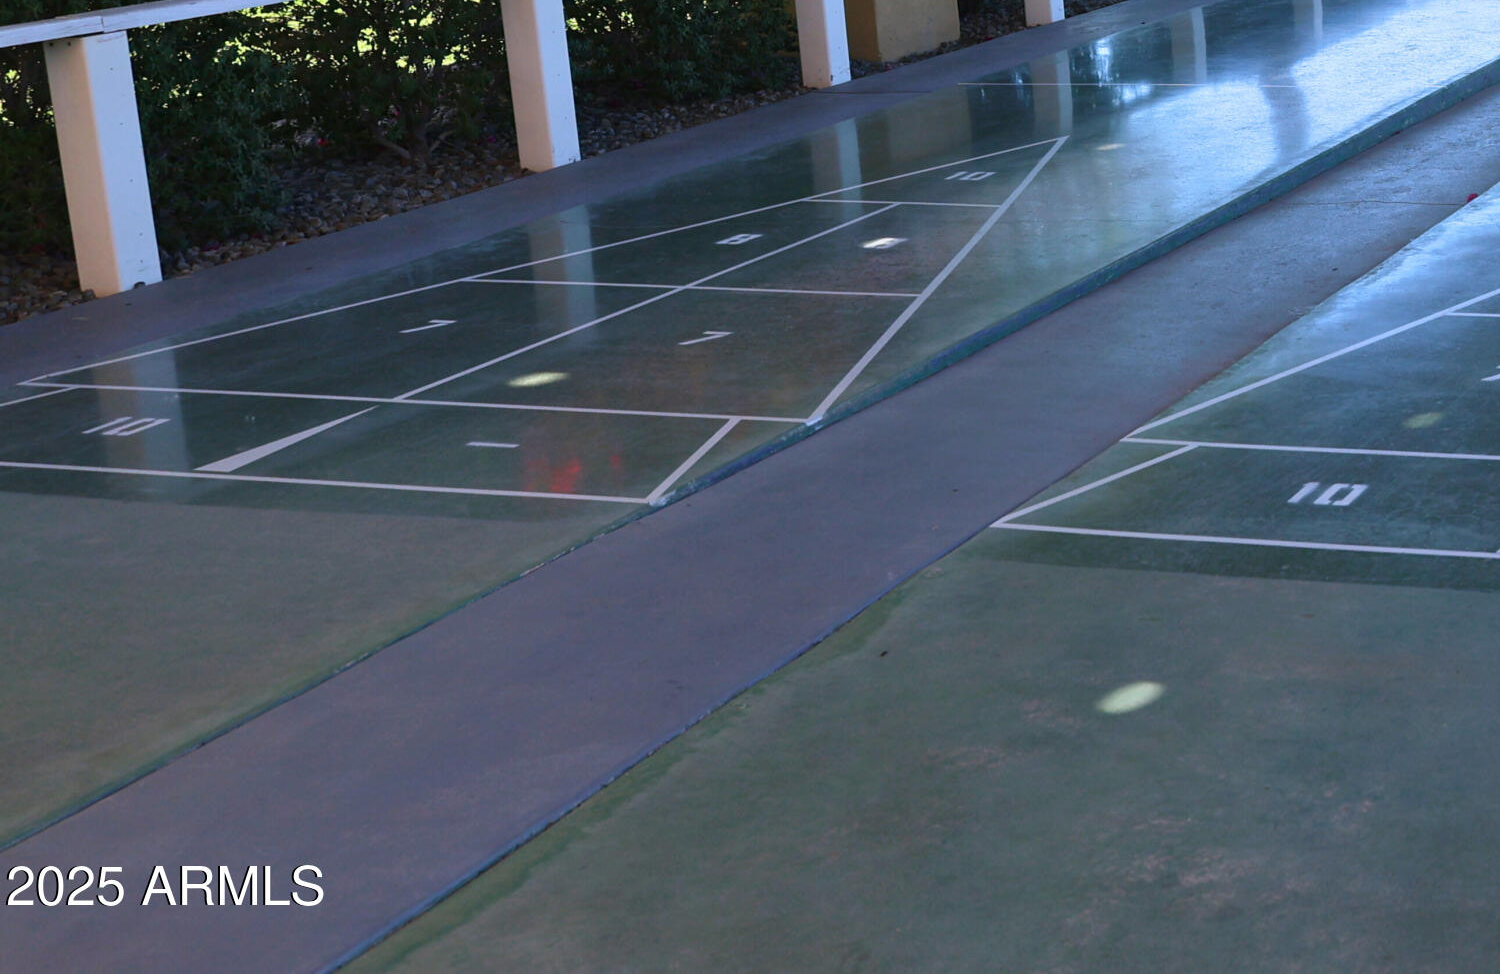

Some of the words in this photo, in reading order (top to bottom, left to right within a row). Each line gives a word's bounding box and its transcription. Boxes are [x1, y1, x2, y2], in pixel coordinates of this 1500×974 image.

[715, 233, 763, 245] 8
[399, 319, 457, 333] 7
[677, 330, 734, 345] 7
[82, 416, 171, 436] 10
[1287, 481, 1369, 506] 10
